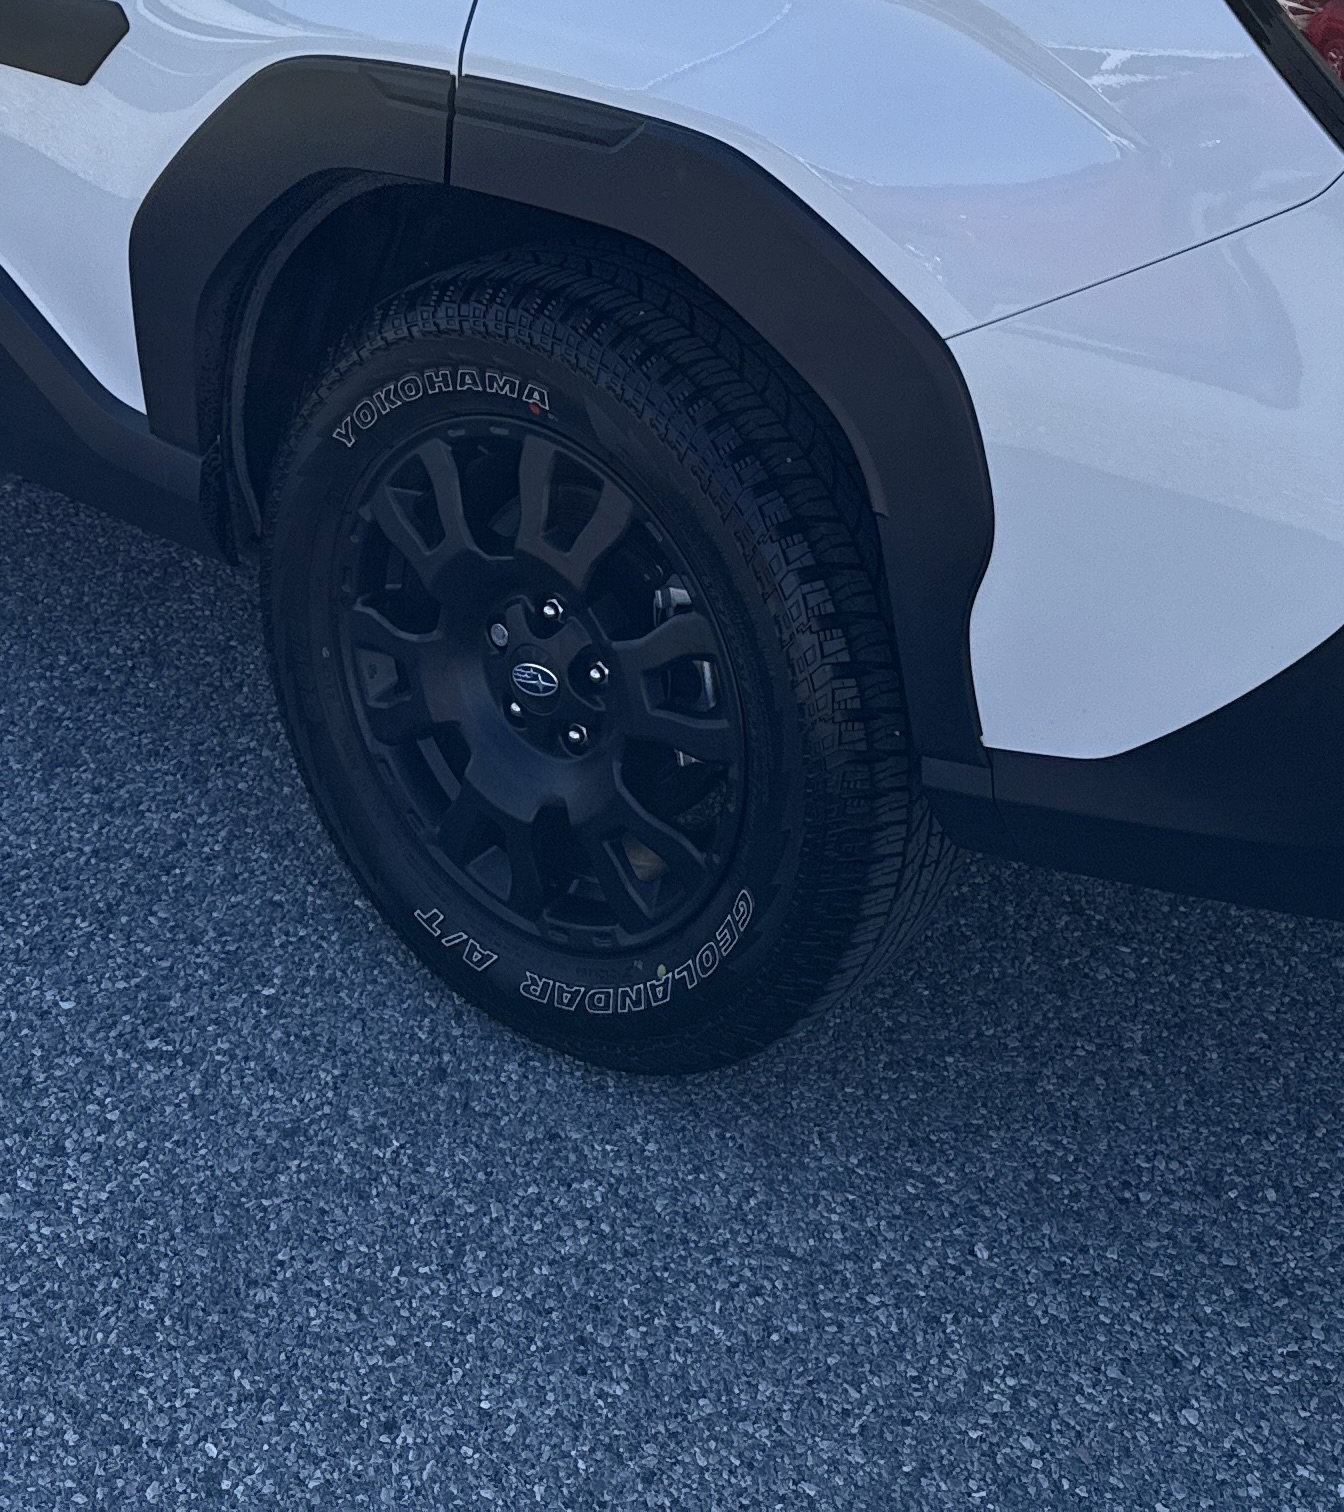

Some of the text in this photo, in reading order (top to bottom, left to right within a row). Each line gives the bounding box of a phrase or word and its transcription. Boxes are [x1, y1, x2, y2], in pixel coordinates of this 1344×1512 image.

[332, 369, 550, 448] YOKOHAMA
[413, 888, 754, 1014] GEOLANDAR A/T
